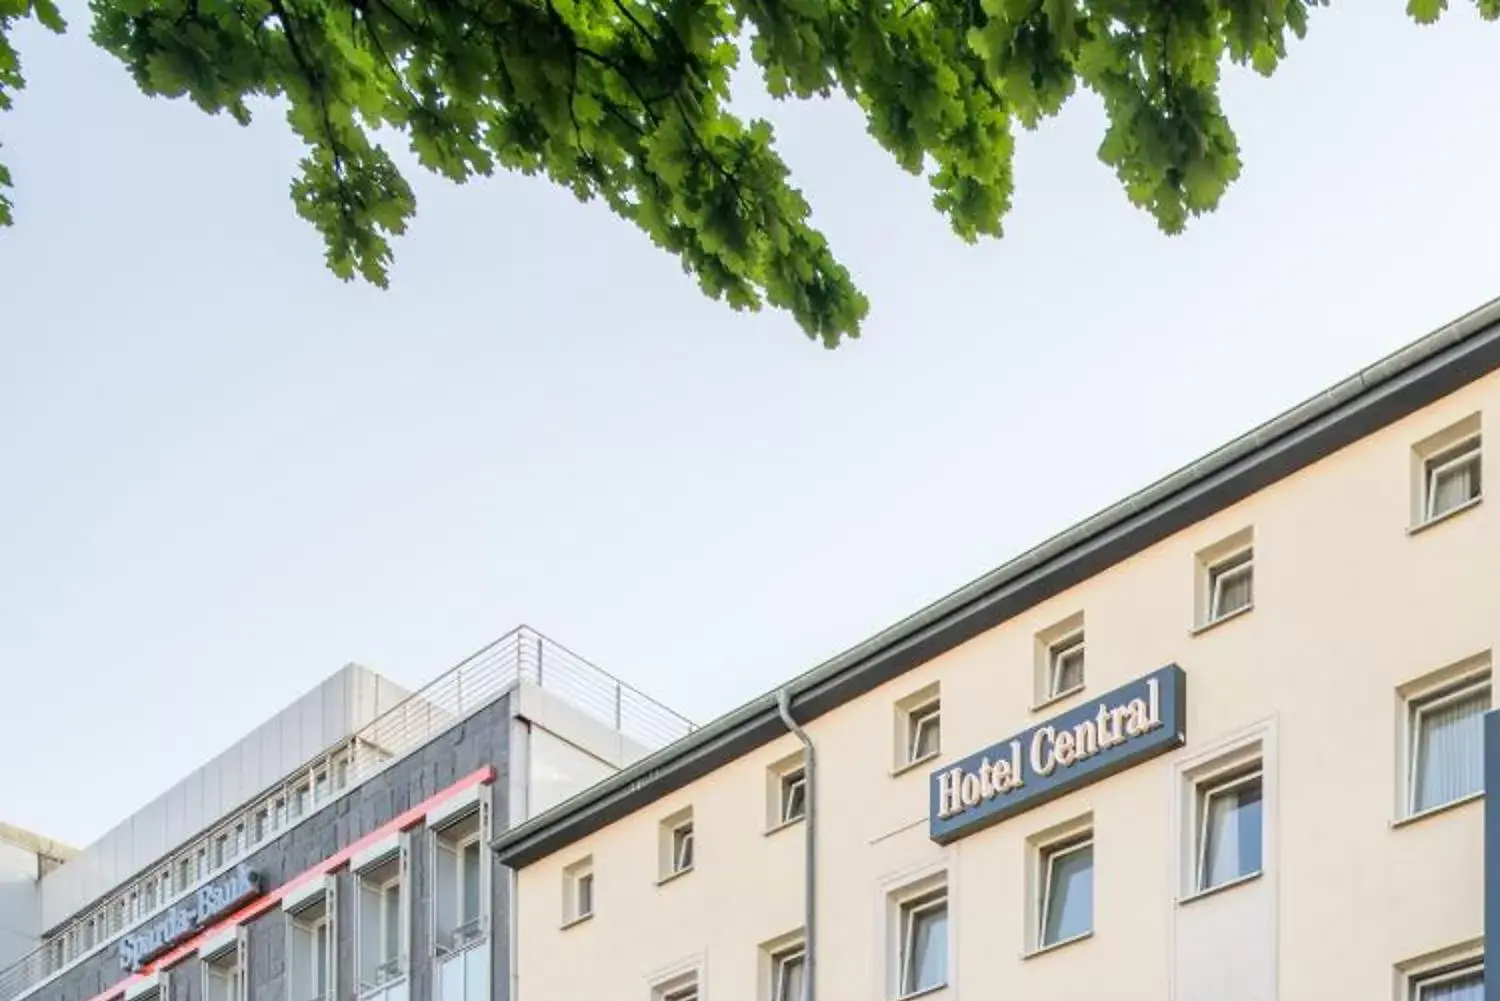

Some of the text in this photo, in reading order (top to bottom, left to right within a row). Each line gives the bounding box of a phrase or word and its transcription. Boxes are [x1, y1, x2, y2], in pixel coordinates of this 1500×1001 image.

[937, 678, 1162, 818] Hotel Central
[119, 864, 256, 973] Sparda-Bank
